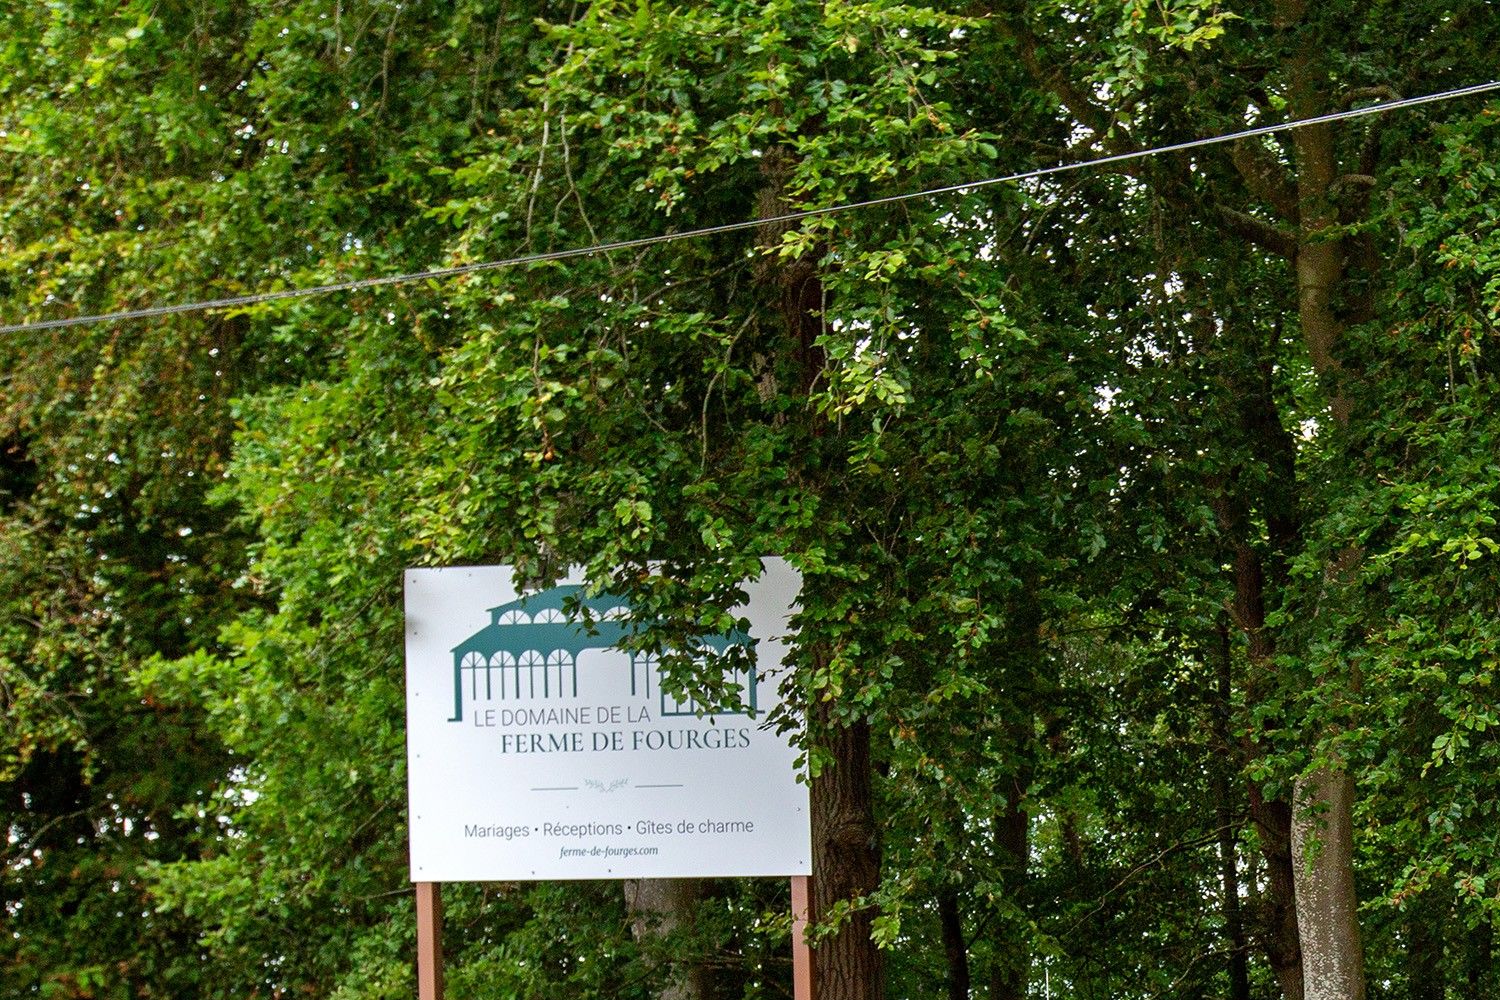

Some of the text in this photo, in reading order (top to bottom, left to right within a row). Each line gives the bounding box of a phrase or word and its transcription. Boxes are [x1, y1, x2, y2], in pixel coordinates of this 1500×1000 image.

[474, 705, 651, 727] LE DOMAINE DE LA
[502, 728, 750, 753] FERME DE FOURGES
[464, 818, 754, 841] Mariages Réceptions Gîtes de charme
[559, 845, 659, 859] ferme-de-fourges.com
